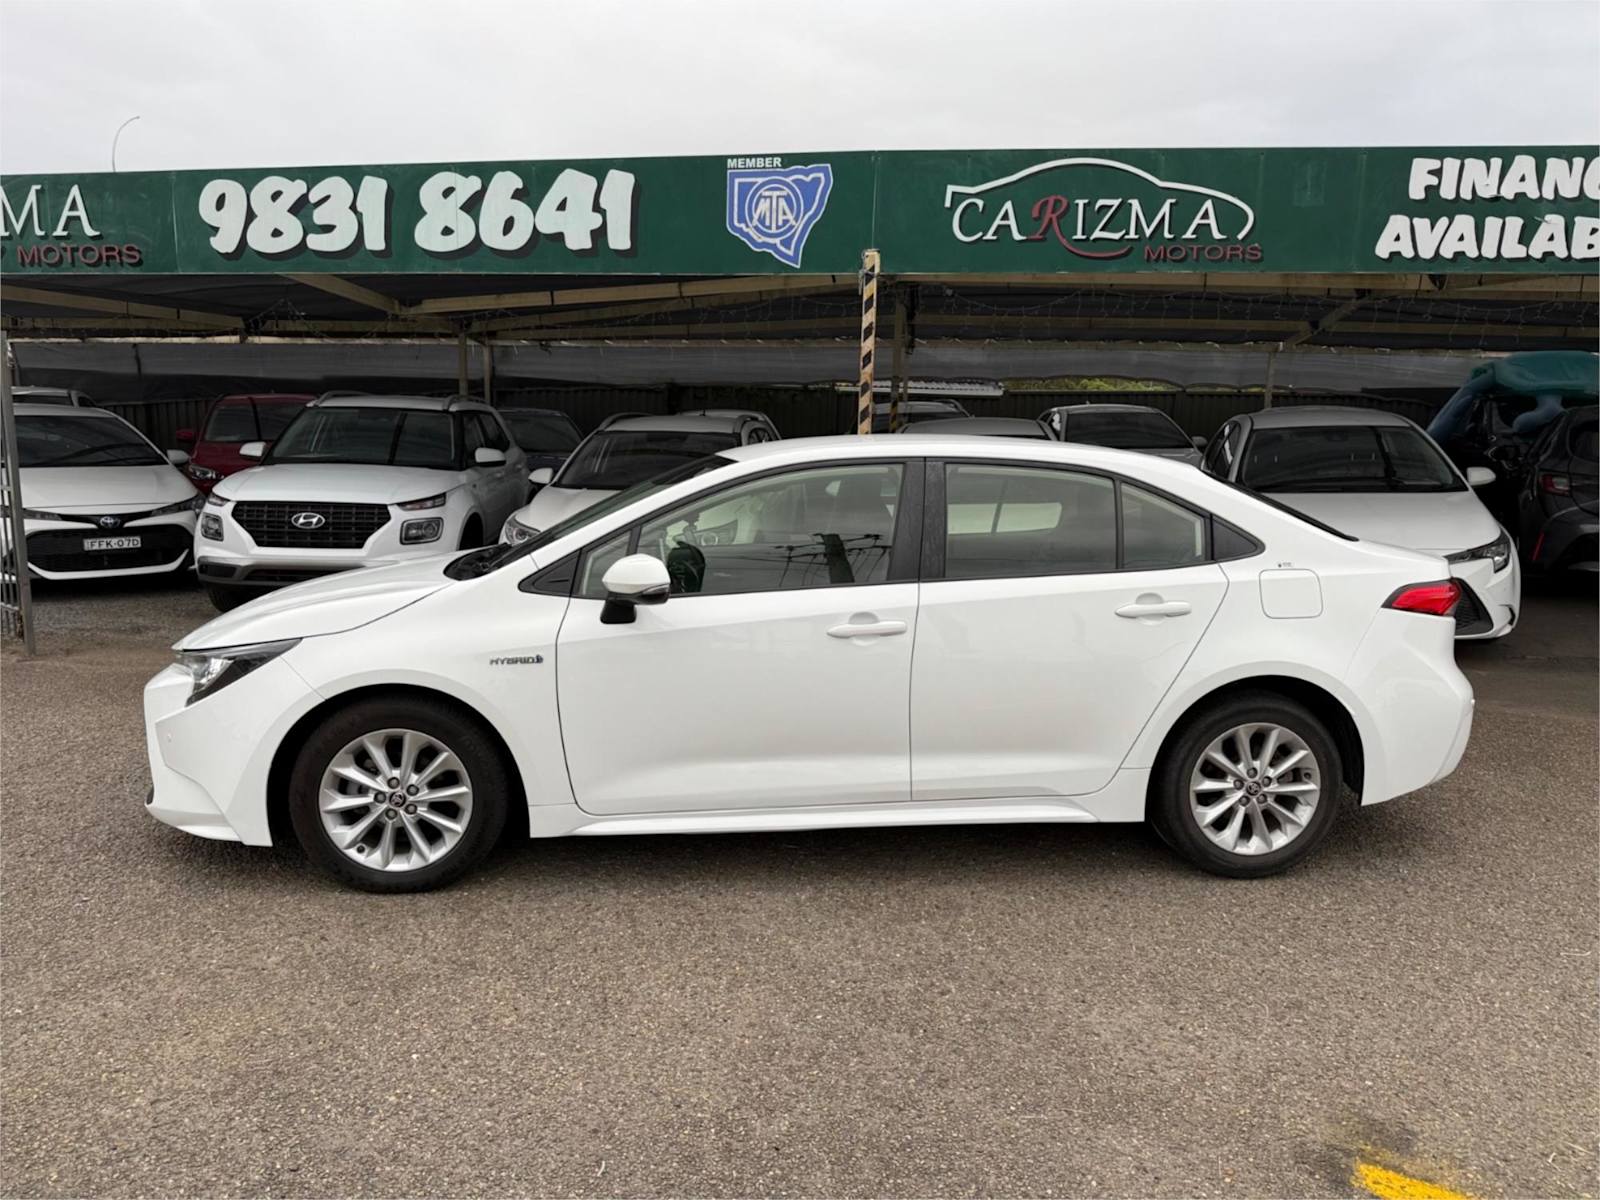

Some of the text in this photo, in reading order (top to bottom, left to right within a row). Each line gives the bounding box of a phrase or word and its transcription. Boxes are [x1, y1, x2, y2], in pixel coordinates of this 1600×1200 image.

[727, 157, 782, 169] MEMBER
[0, 184, 101, 237] MA
[199, 168, 636, 254] 9831 8641
[752, 190, 797, 233] MTA
[952, 195, 1227, 257] CARIZMA
[16, 244, 142, 265] MOTORS
[1144, 244, 1263, 261] MOTORS
[1374, 214, 1600, 259] AVAILAB
[489, 656, 535, 665] HYBRID
